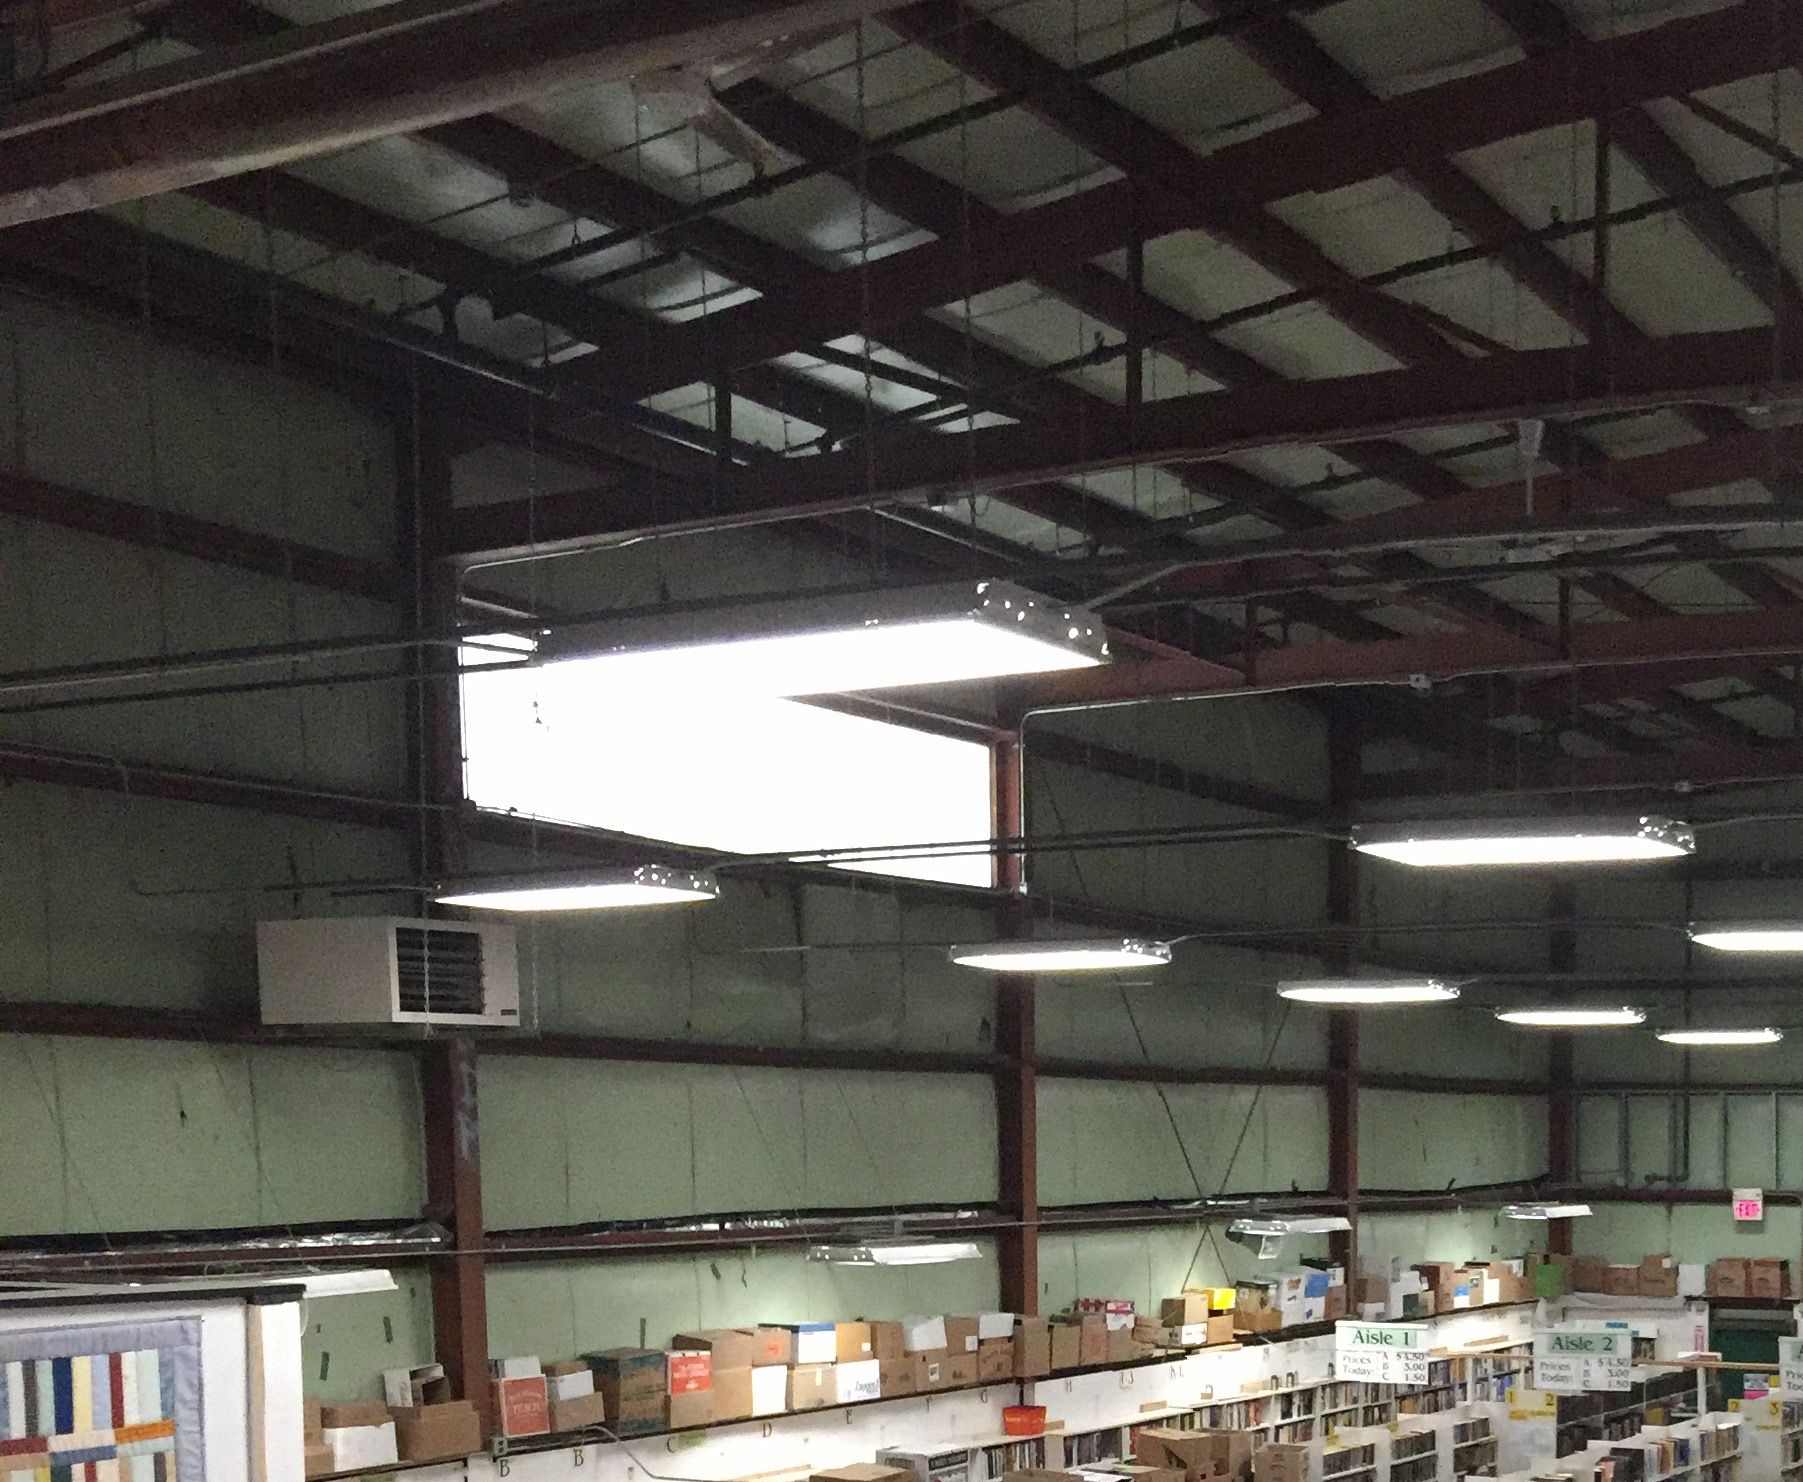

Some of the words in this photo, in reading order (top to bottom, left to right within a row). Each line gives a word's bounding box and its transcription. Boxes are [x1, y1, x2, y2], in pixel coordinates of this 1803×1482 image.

[1351, 1329, 1394, 1346] Aisle
[1402, 1328, 1410, 1346] 1
[1550, 1336, 1595, 1351] Aisle
[1604, 1336, 1613, 1351] 2
[1342, 1355, 1371, 1365] Prices
[1540, 1362, 1570, 1371] Prices
[762, 1423, 772, 1438] D
